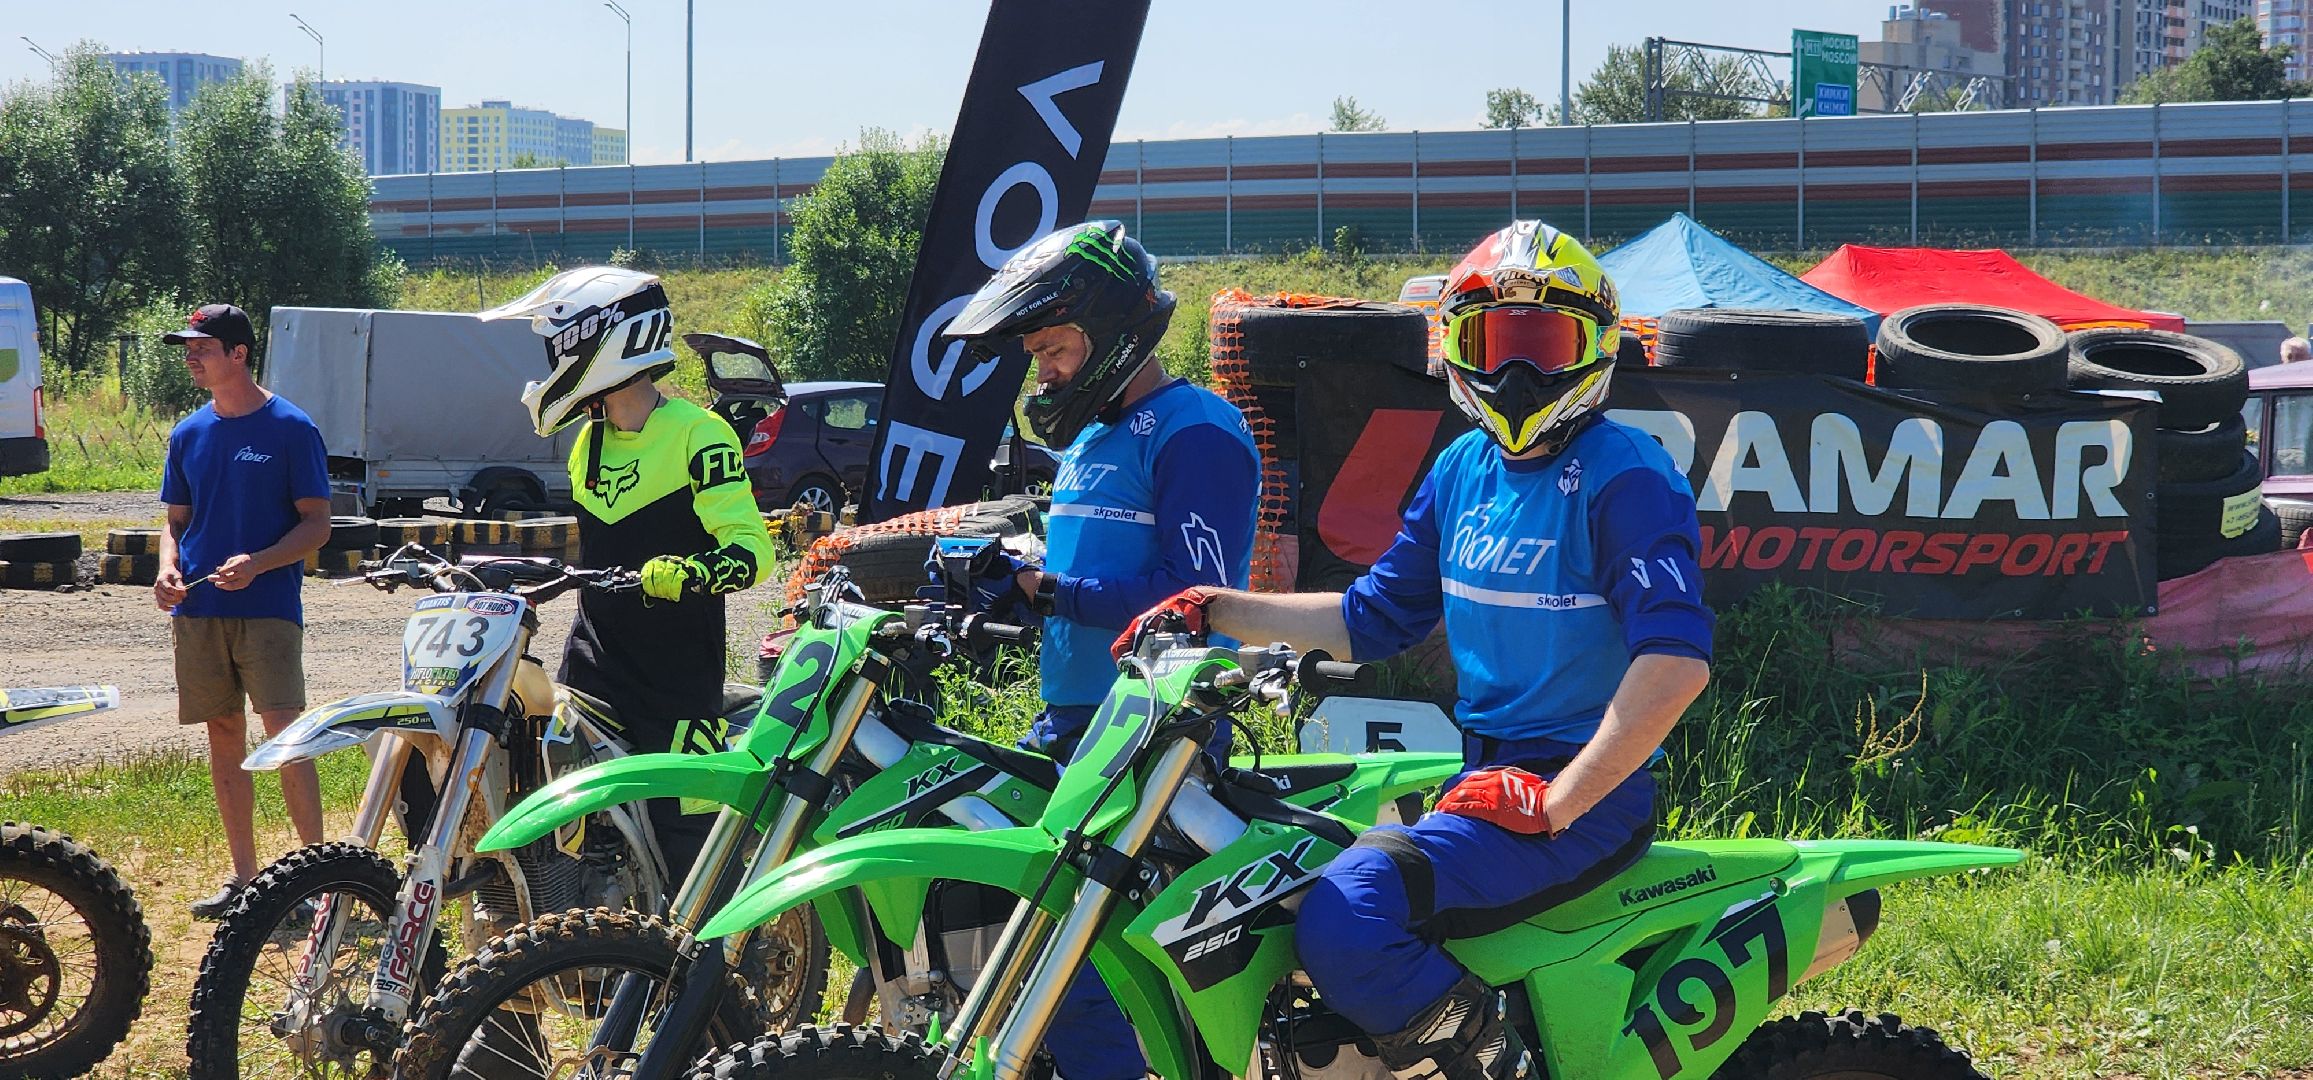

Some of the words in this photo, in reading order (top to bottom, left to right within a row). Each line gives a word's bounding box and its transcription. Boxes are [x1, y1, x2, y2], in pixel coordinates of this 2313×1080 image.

[1822, 36, 1857, 50] МОСКВА
[1821, 51, 1857, 65] MOSCOW
[1818, 87, 1848, 99] ХИМКИ
[1818, 101, 1848, 114] KHIMKI
[878, 60, 1105, 509] VOGE
[1016, 307, 1029, 317] NOT
[1029, 300, 1042, 310] FOR
[1042, 291, 1059, 303] SALE
[552, 302, 625, 357] 100%
[1093, 506, 1137, 521] skpolet
[1698, 525, 2130, 577] MOTORSPORT
[472, 601, 487, 610] HOT
[487, 601, 509, 612] RODS
[1537, 595, 1577, 608] skolet
[410, 616, 490, 658] 743
[407, 679, 457, 687] RACING
[397, 716, 420, 726] 250
[903, 755, 961, 800] KX
[1181, 835, 1317, 932] KX
[1618, 864, 1718, 907] Kawasaki
[1183, 924, 1243, 963] 250
[1621, 902, 1788, 1080] 197
